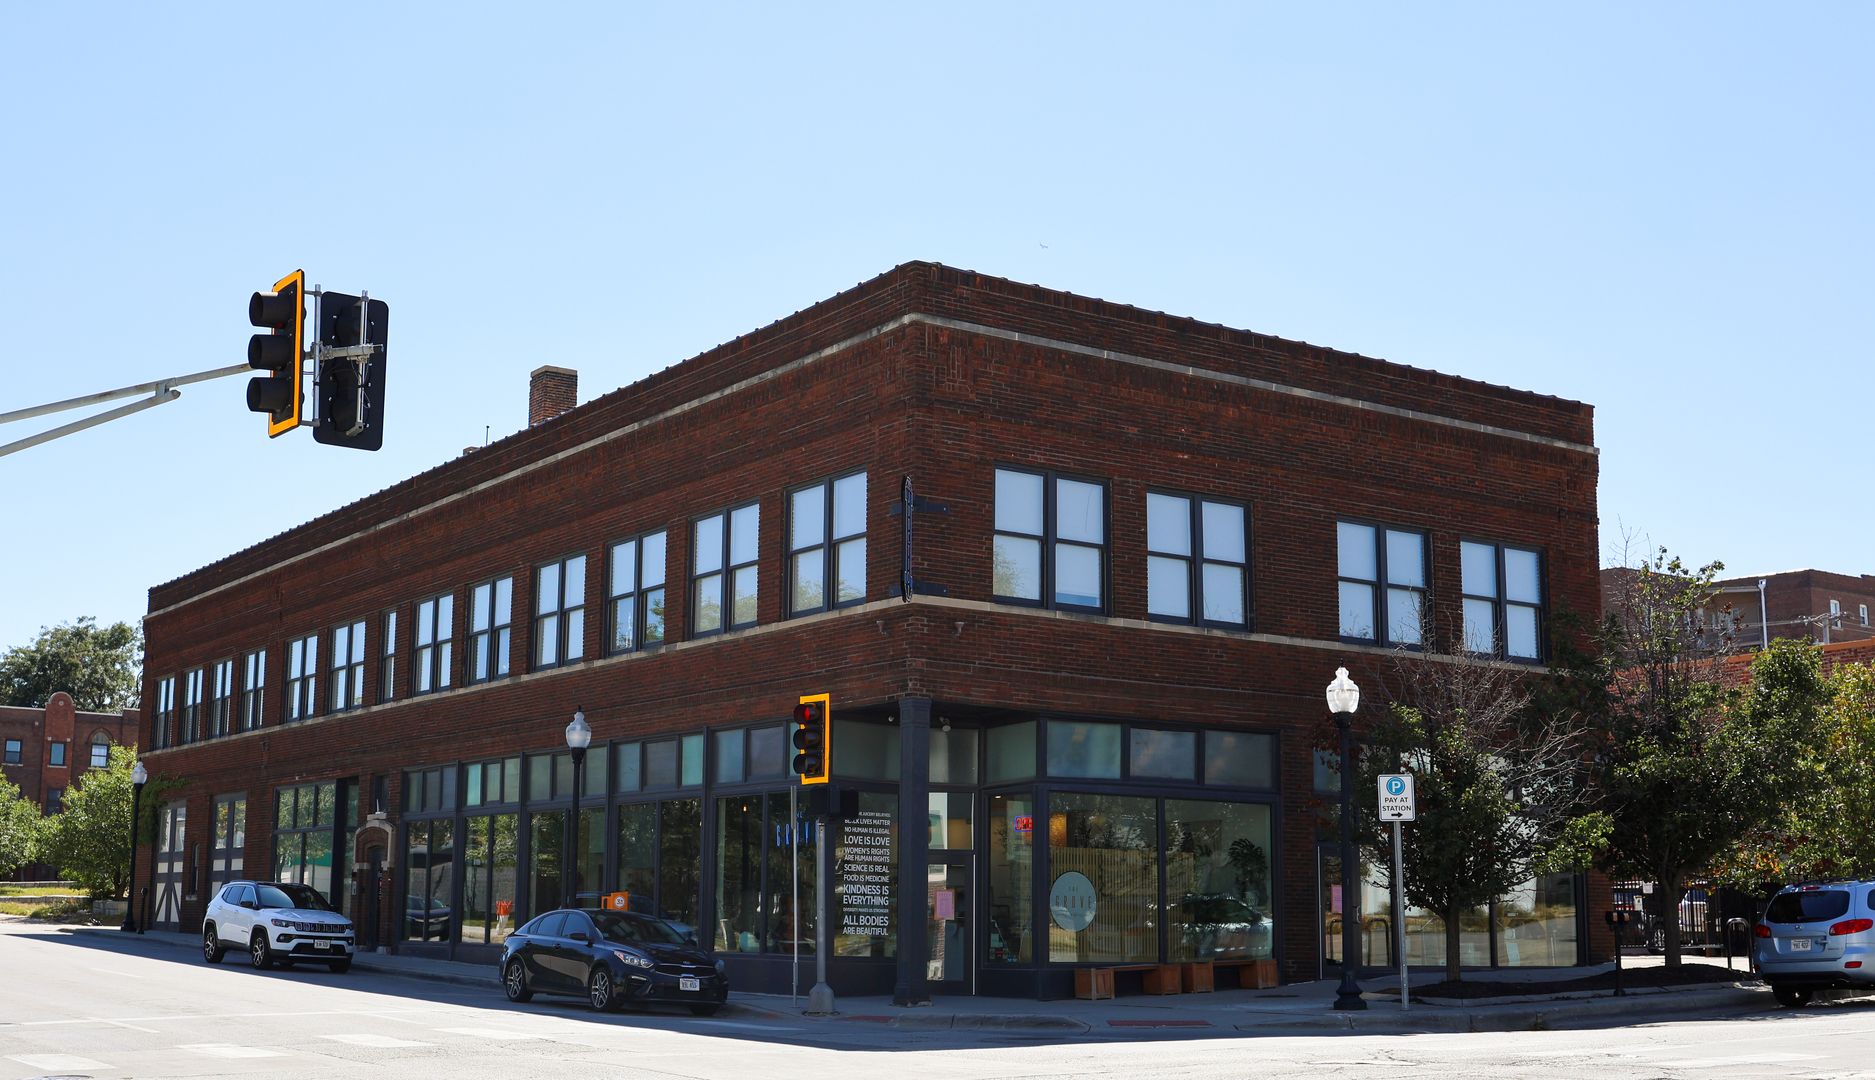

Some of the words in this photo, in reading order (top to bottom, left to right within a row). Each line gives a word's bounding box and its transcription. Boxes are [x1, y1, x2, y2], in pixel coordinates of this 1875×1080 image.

[844, 835, 863, 844] LOVE
[864, 836, 870, 844] IS
[872, 837, 890, 846] LOVE
[843, 884, 881, 894] KINDNESS
[882, 885, 889, 894] IS
[843, 895, 889, 906] EVERYTHING
[843, 914, 858, 925] ALL
[860, 915, 889, 926] BODIES
[856, 927, 889, 936] BEAUTIFUL
